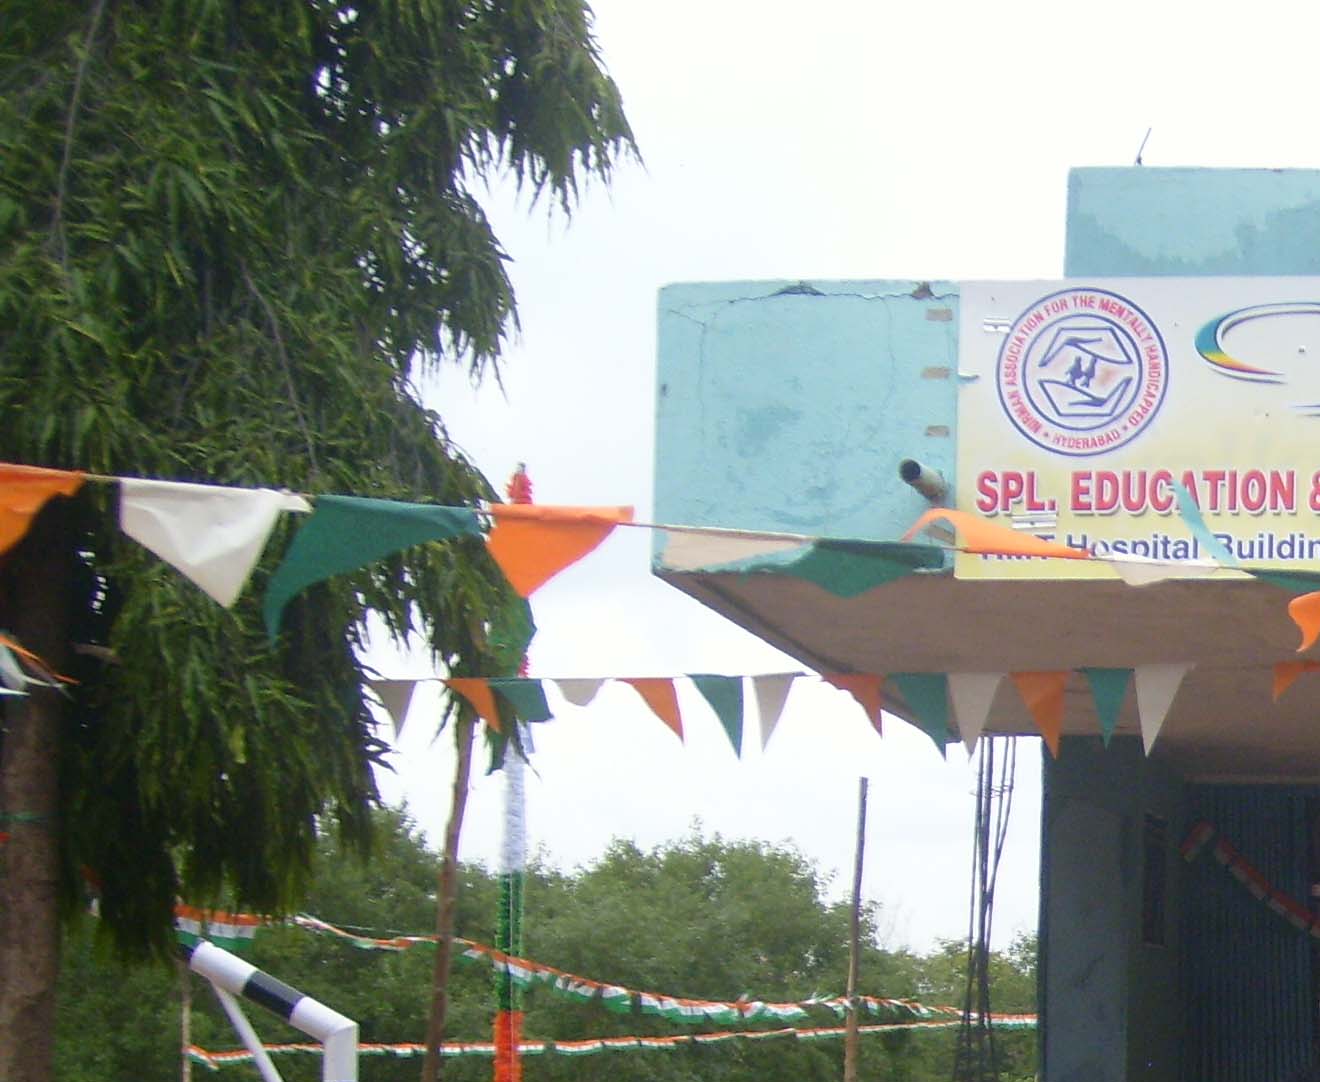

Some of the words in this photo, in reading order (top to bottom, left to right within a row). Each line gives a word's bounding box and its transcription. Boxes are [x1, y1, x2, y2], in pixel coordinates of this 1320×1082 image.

[1004, 311, 1045, 386] ASSOCIATION
[1044, 298, 1069, 317] FOR
[1072, 295, 1096, 309] THE
[1098, 297, 1154, 343] MENTALLY
[1127, 344, 1161, 427] HANDICAPPED
[1052, 428, 1121, 449] HYDERABAD
[975, 469, 1057, 513] SPL.
[1070, 469, 1296, 513] EDUCATION
